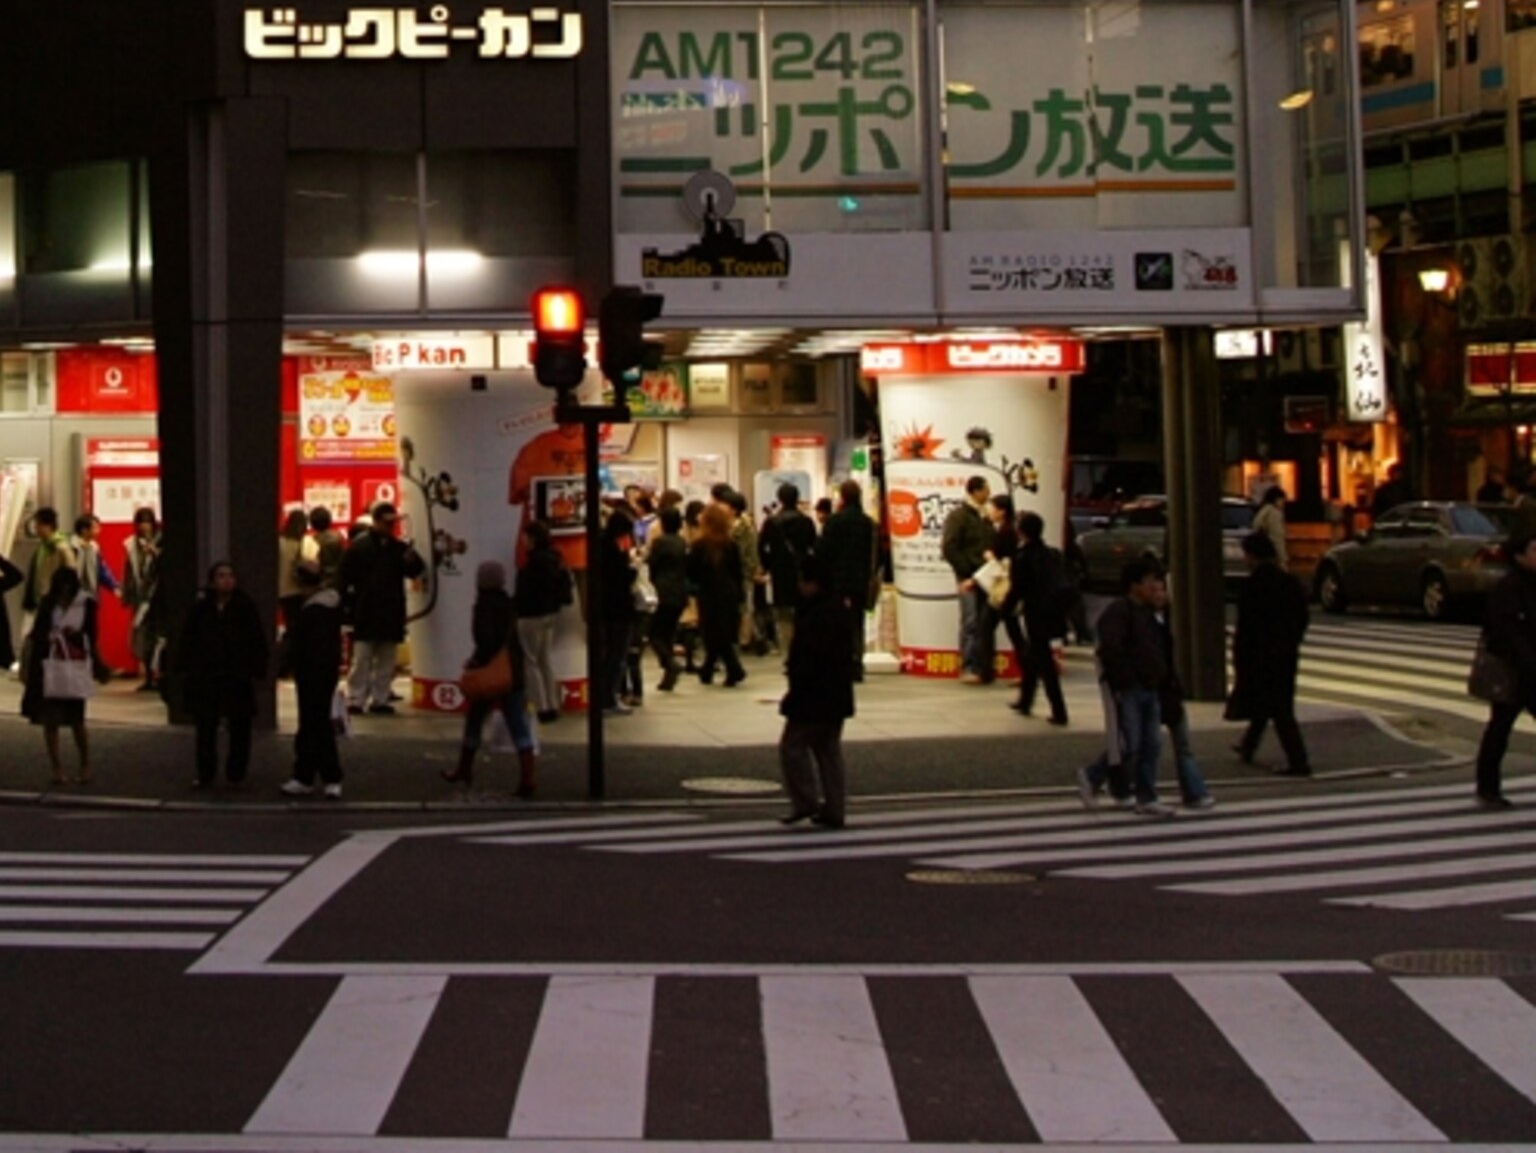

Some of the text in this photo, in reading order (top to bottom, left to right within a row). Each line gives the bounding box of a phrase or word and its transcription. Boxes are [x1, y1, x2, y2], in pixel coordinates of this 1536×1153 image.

[243, 4, 582, 59] ビックピーカン
[620, 83, 1237, 178] ニッポン放送
[644, 258, 786, 276] Radio Town
[1001, 256, 1061, 266] RADIO
[1069, 256, 1114, 266] 1242
[969, 268, 1114, 291] ニッポン放送
